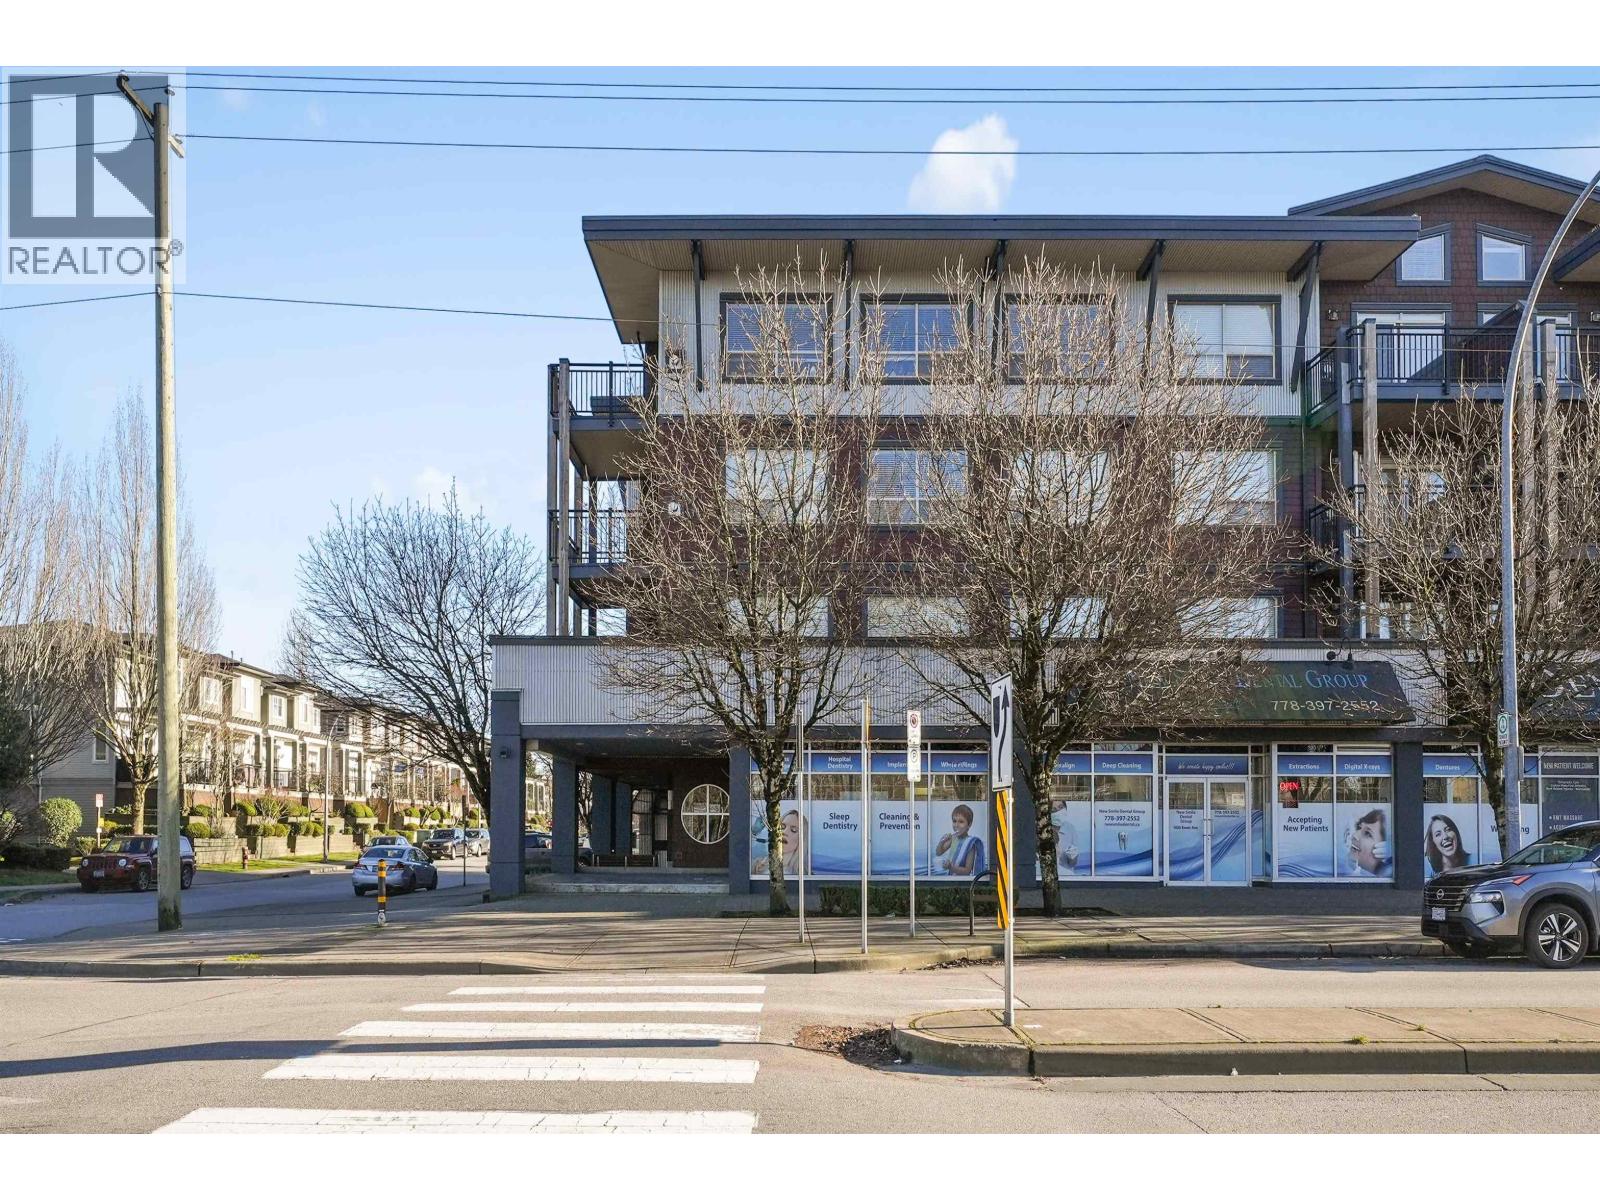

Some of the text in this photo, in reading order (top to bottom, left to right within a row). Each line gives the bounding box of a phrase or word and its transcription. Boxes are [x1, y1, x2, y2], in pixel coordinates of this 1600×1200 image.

[1306, 670, 1367, 688] GROUP
[1272, 700, 1379, 711] 778-397-2552
[1102, 761, 1141, 770] Deep Cleaning
[1344, 763, 1363, 771] Digital
[1279, 781, 1299, 792] OPEN
[829, 812, 850, 821] Sleep
[1287, 816, 1322, 825] Accepting
[823, 821, 858, 831] Dentistry
[880, 822, 921, 830] Preventin
